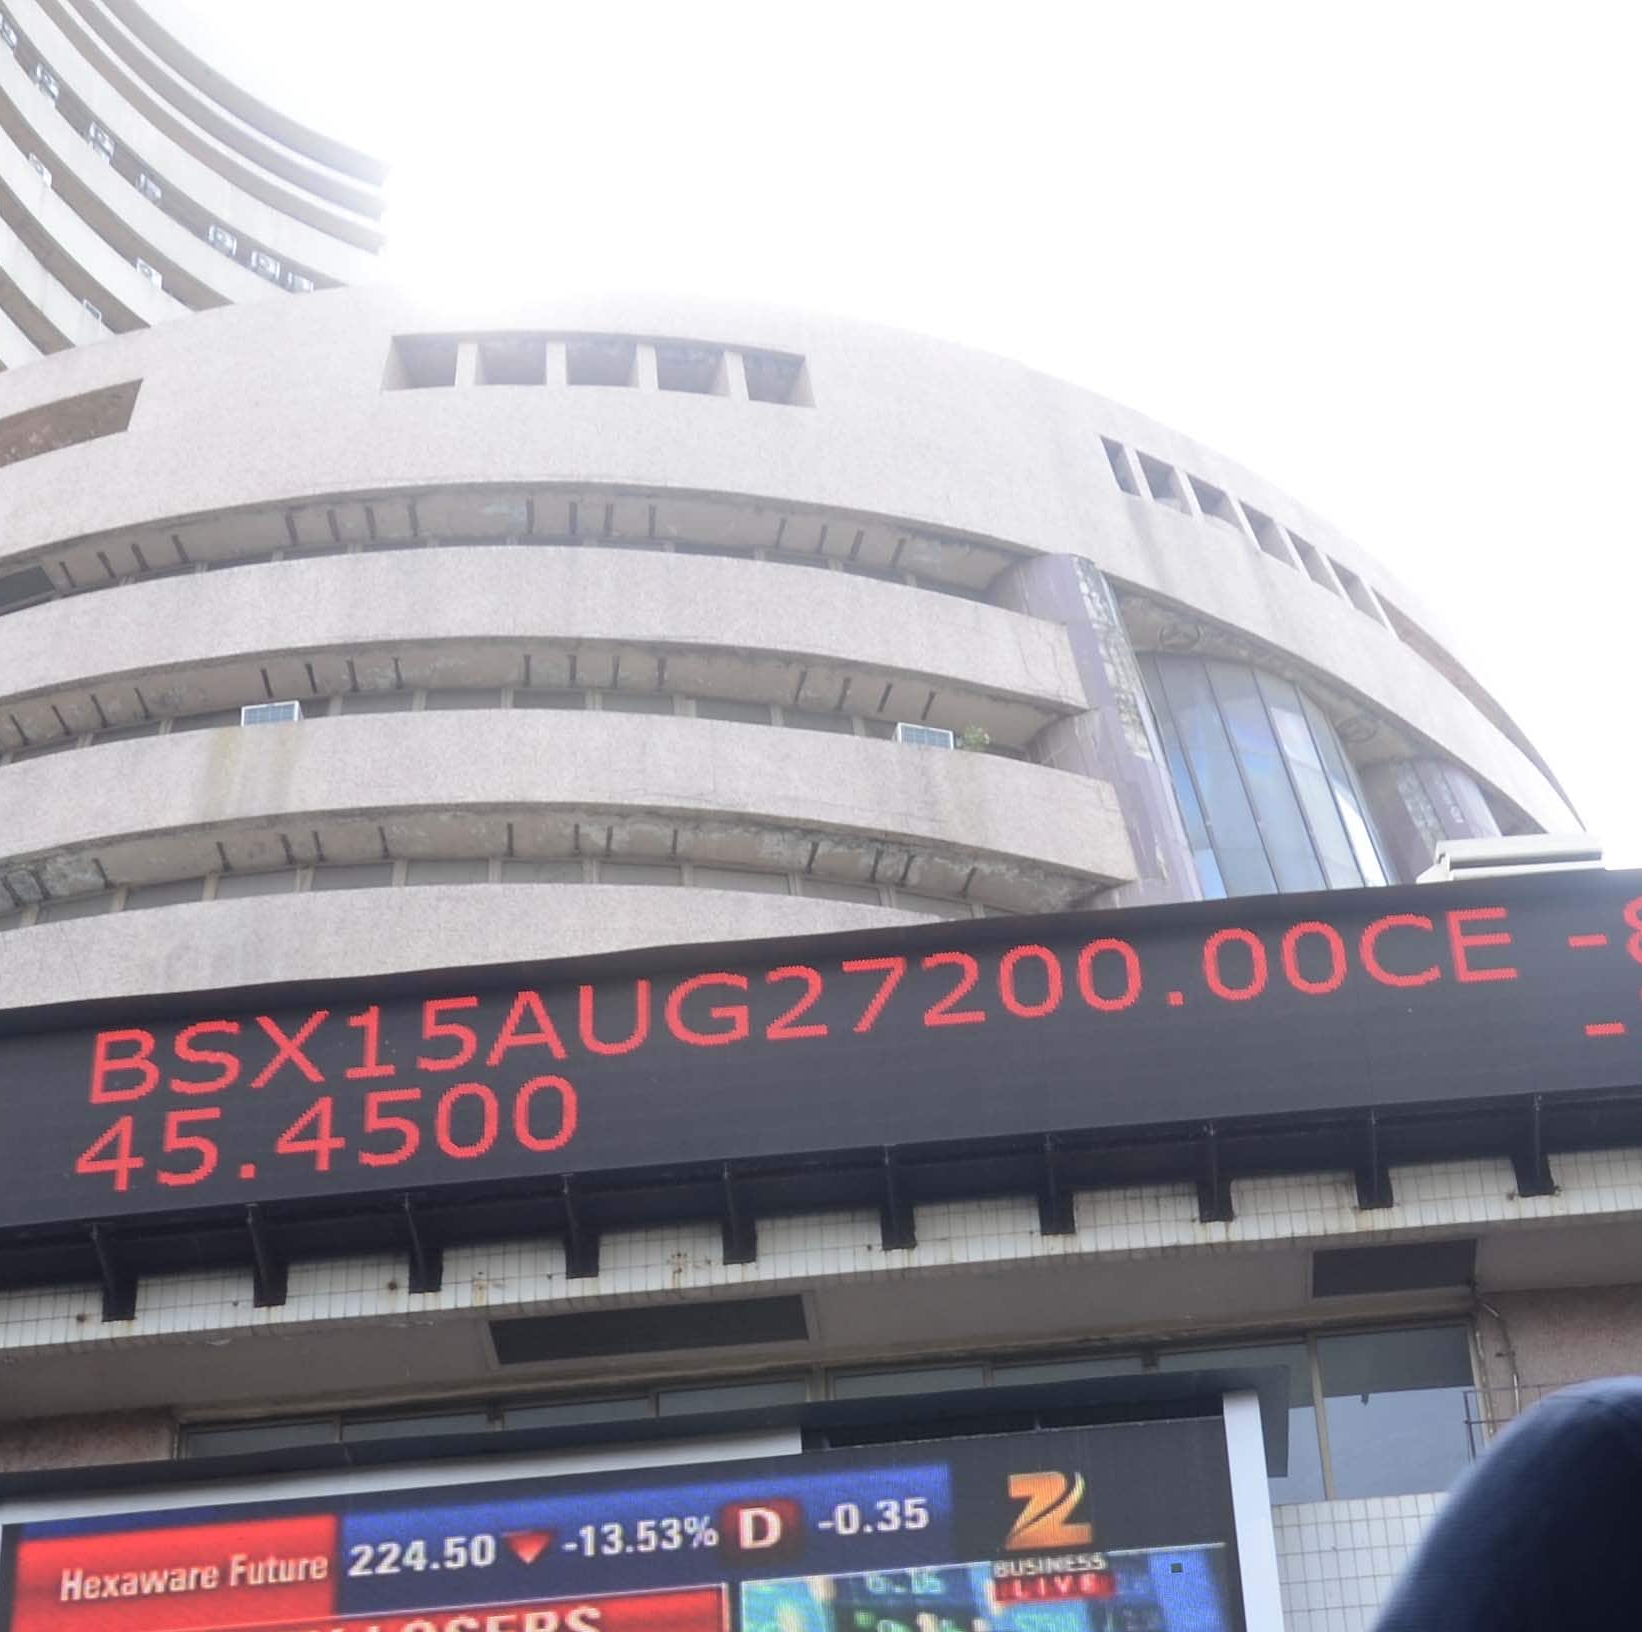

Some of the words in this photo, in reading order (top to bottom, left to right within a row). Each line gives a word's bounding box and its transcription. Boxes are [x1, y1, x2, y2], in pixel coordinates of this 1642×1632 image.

[89, 905, 1520, 1104] BSX15AUG27200.00CE
[74, 1074, 579, 1193] 45.4500
[561, 1515, 720, 1558] -13.53%
[738, 1507, 781, 1550] D
[817, 1496, 930, 1536] -0.35
[60, 1563, 219, 1602] Hexaware
[229, 1553, 328, 1587] Future
[347, 1534, 497, 1578] 224.50
[992, 1551, 1108, 1579] BUSINESS
